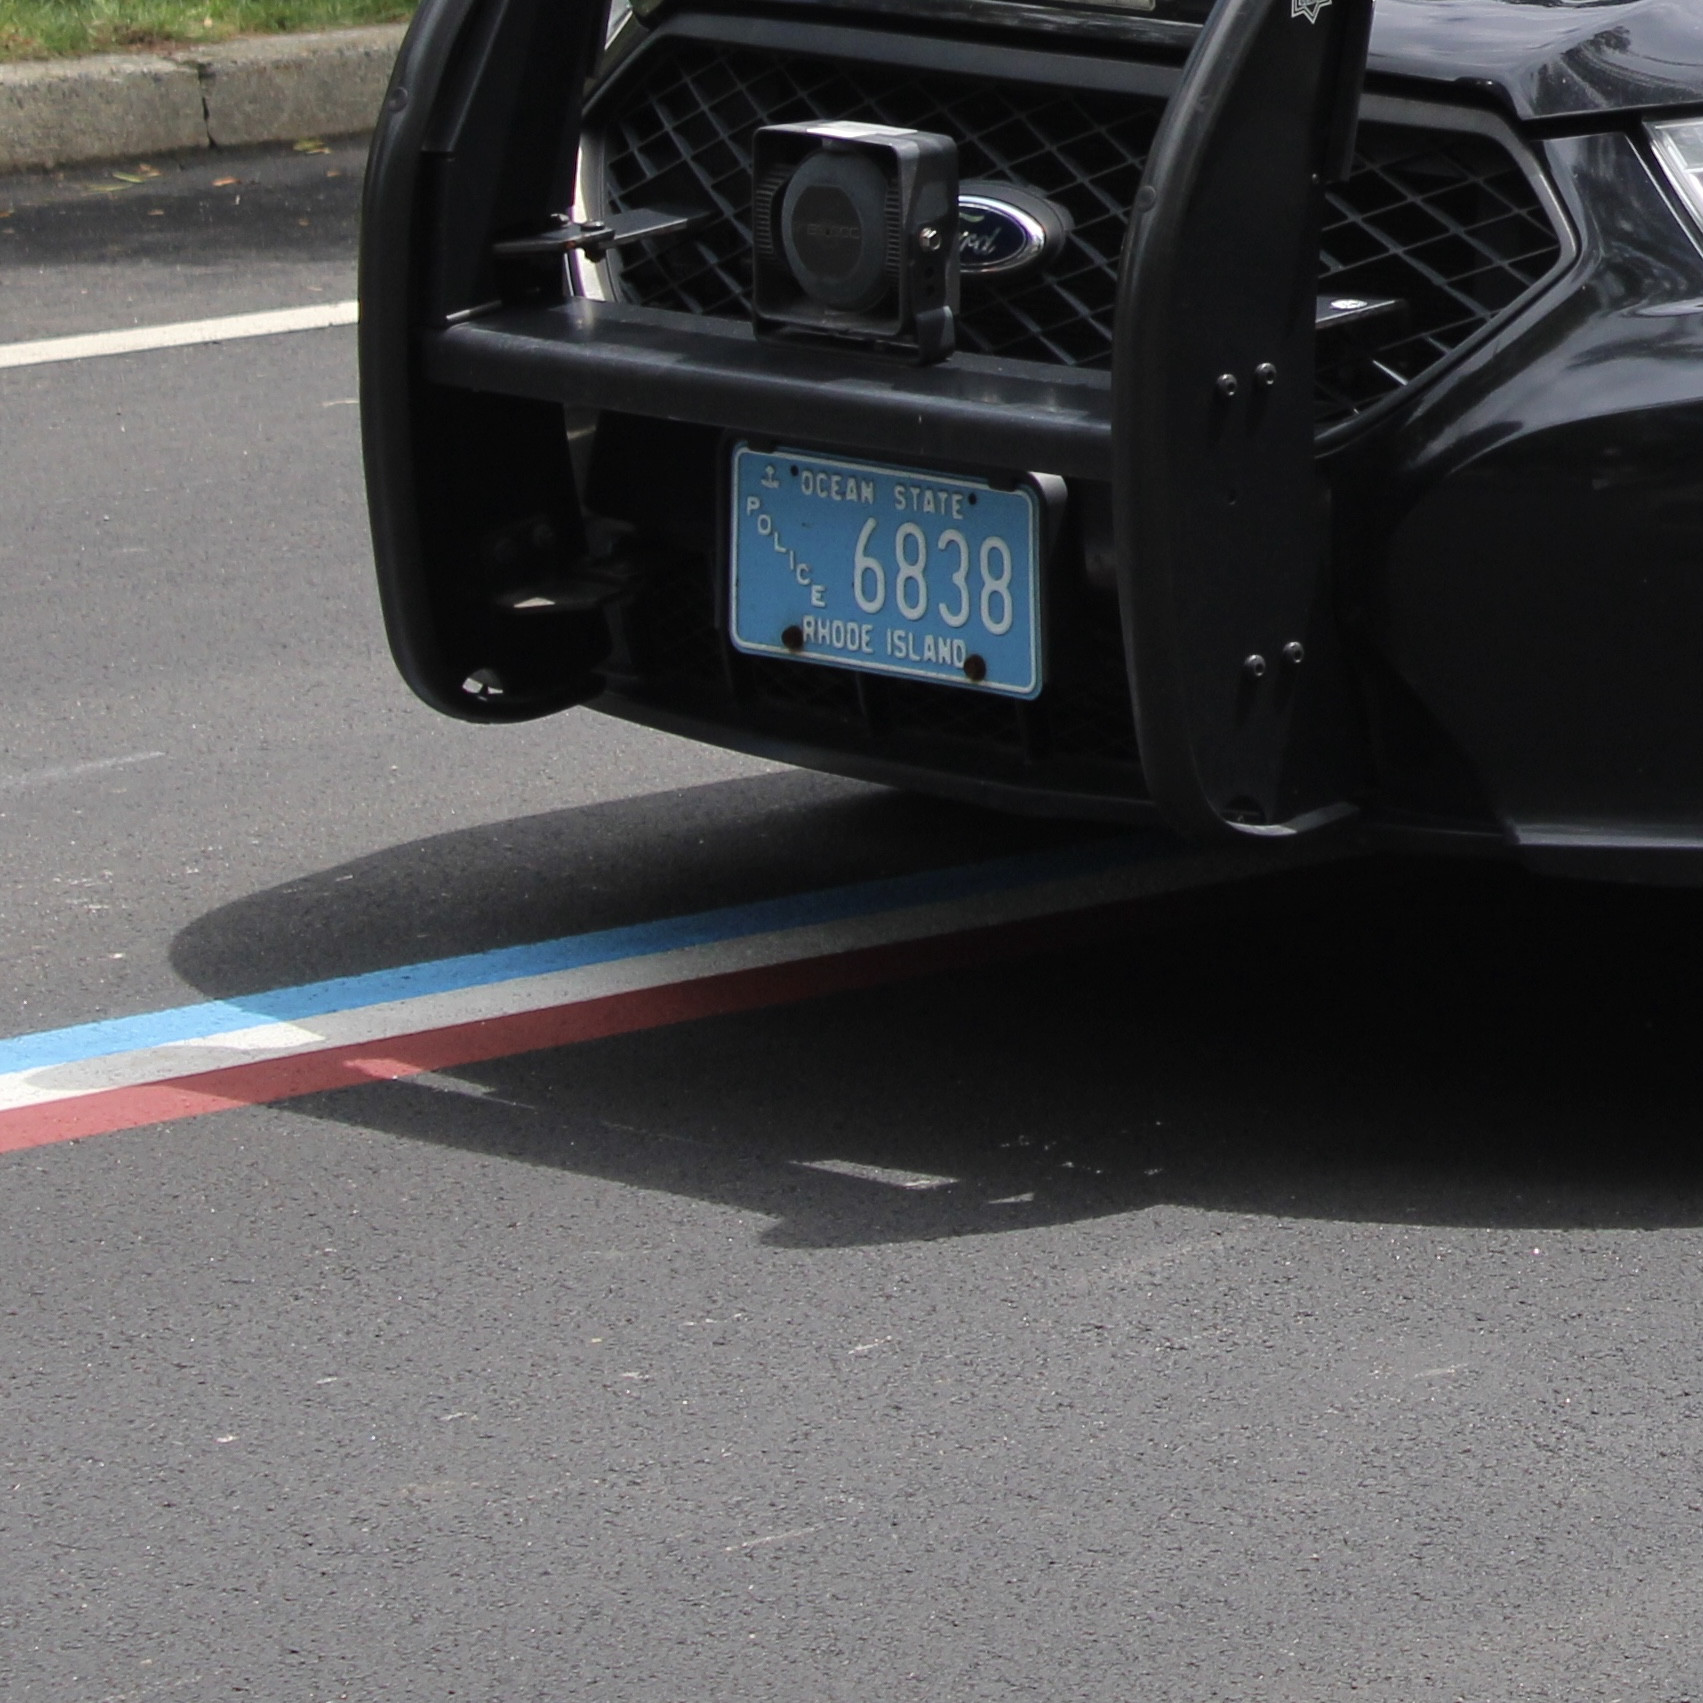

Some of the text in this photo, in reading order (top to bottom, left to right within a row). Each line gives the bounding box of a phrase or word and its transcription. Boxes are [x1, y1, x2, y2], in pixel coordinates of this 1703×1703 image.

[801, 470, 964, 520] OCEAN STATE
[747, 496, 826, 608] POLICE
[853, 517, 1014, 636] 6838
[802, 615, 967, 670] RHODE ISLAND
